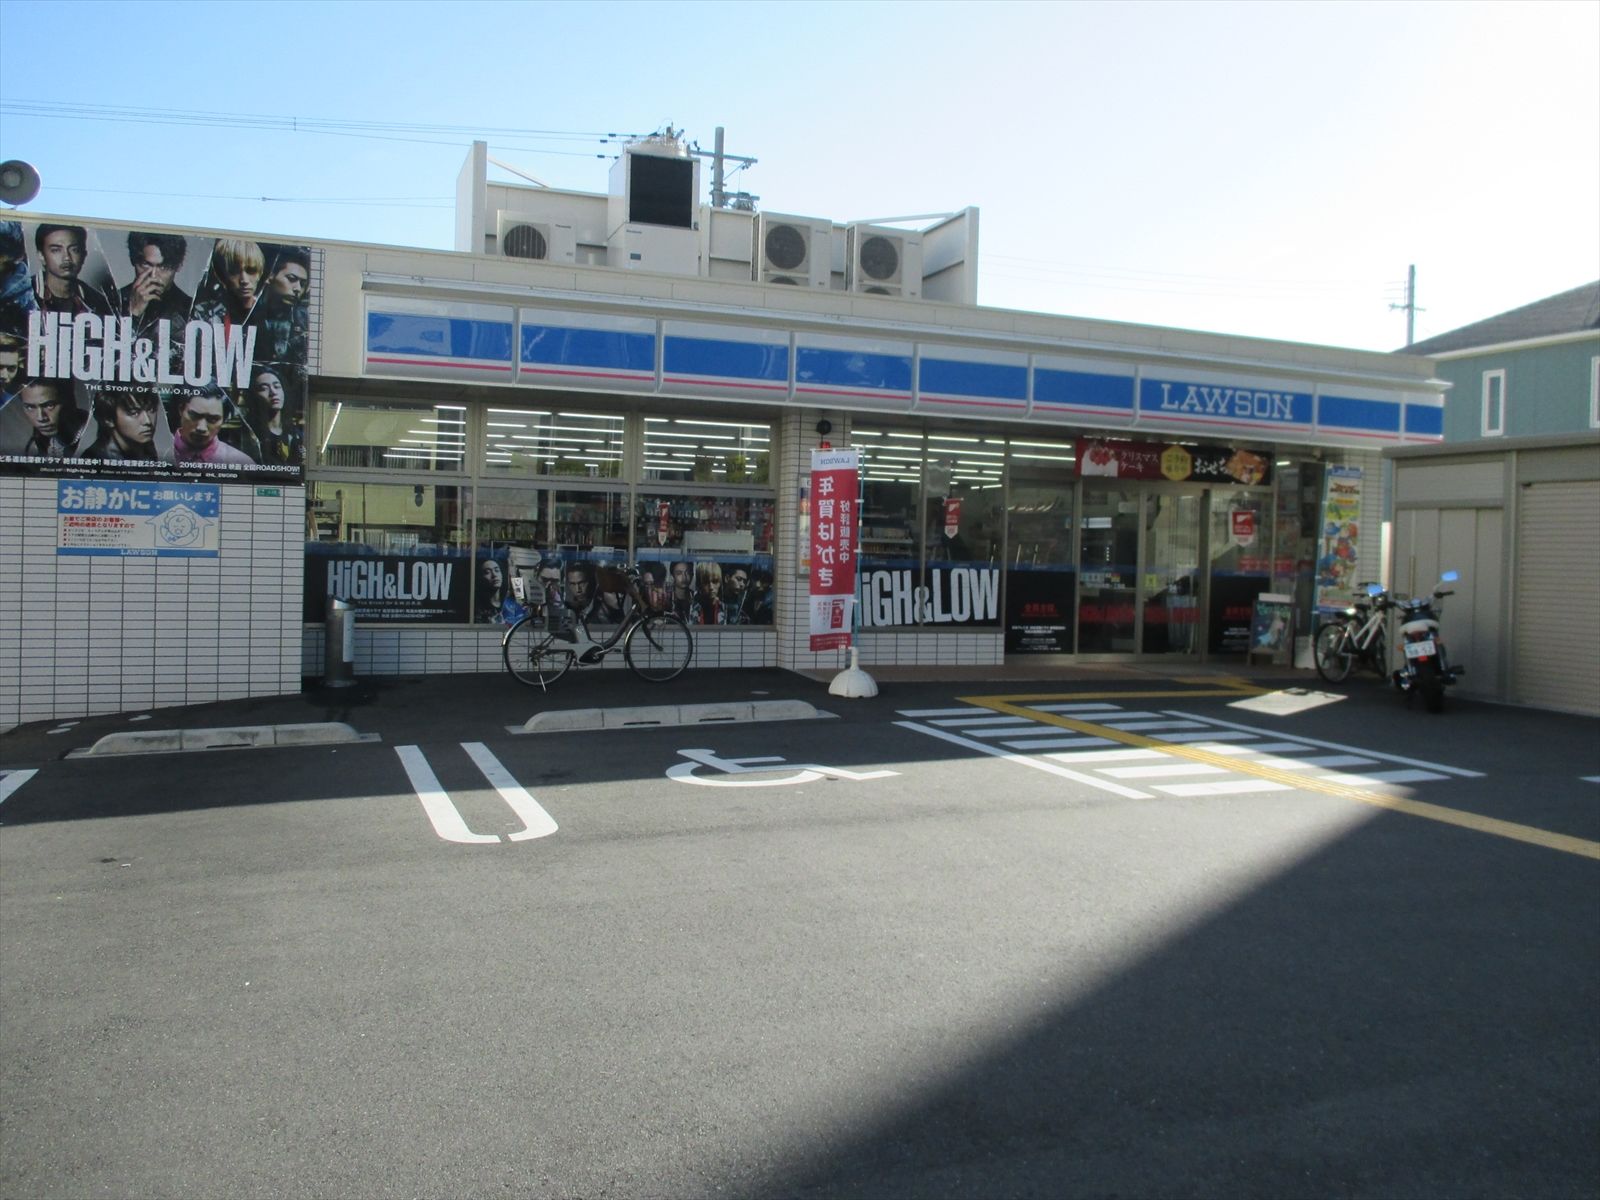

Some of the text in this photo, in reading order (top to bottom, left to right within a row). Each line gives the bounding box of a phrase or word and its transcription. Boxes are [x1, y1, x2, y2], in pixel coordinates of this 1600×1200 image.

[27, 310, 257, 389] HiGH&LOW
[1161, 383, 1293, 420] LAWSON
[61, 486, 150, 510] お静かに
